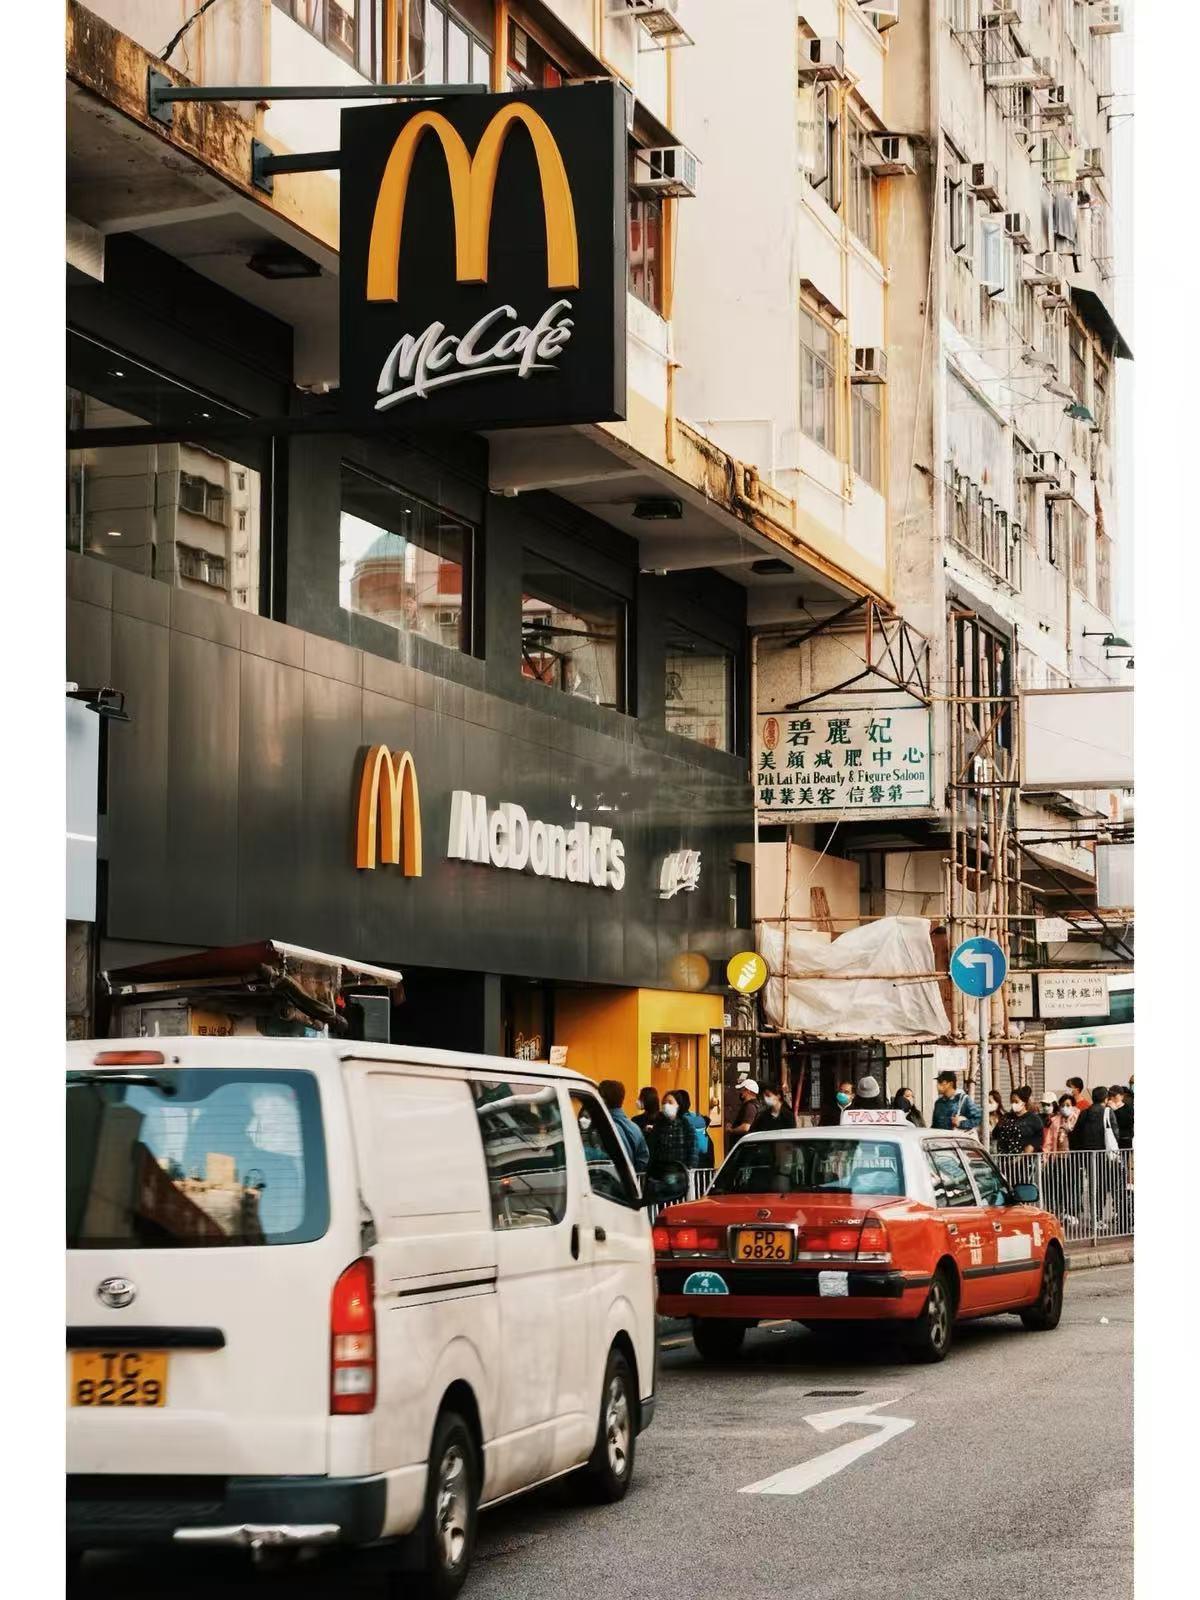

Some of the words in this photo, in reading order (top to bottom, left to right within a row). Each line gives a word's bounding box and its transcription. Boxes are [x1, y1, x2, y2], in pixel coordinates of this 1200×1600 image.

[375, 299, 575, 408] McCafé
[786, 717, 892, 746] 碧麗妃
[758, 773, 775, 786] Pik
[777, 772, 793, 786] Lai
[796, 772, 810, 785] Fai
[814, 771, 845, 786] Beauty
[858, 770, 891, 786] Figure
[893, 769, 925, 782] Saloon
[760, 787, 836, 805] 專業美容
[846, 784, 924, 803] 信譽第一
[447, 790, 626, 891] McDonald's
[848, 1111, 897, 1122] TAXI
[754, 1232, 775, 1245] PD
[743, 1245, 785, 1259] 9826
[701, 1278, 710, 1288] 4
[101, 1353, 143, 1380] TC
[76, 1379, 162, 1406] 8229
